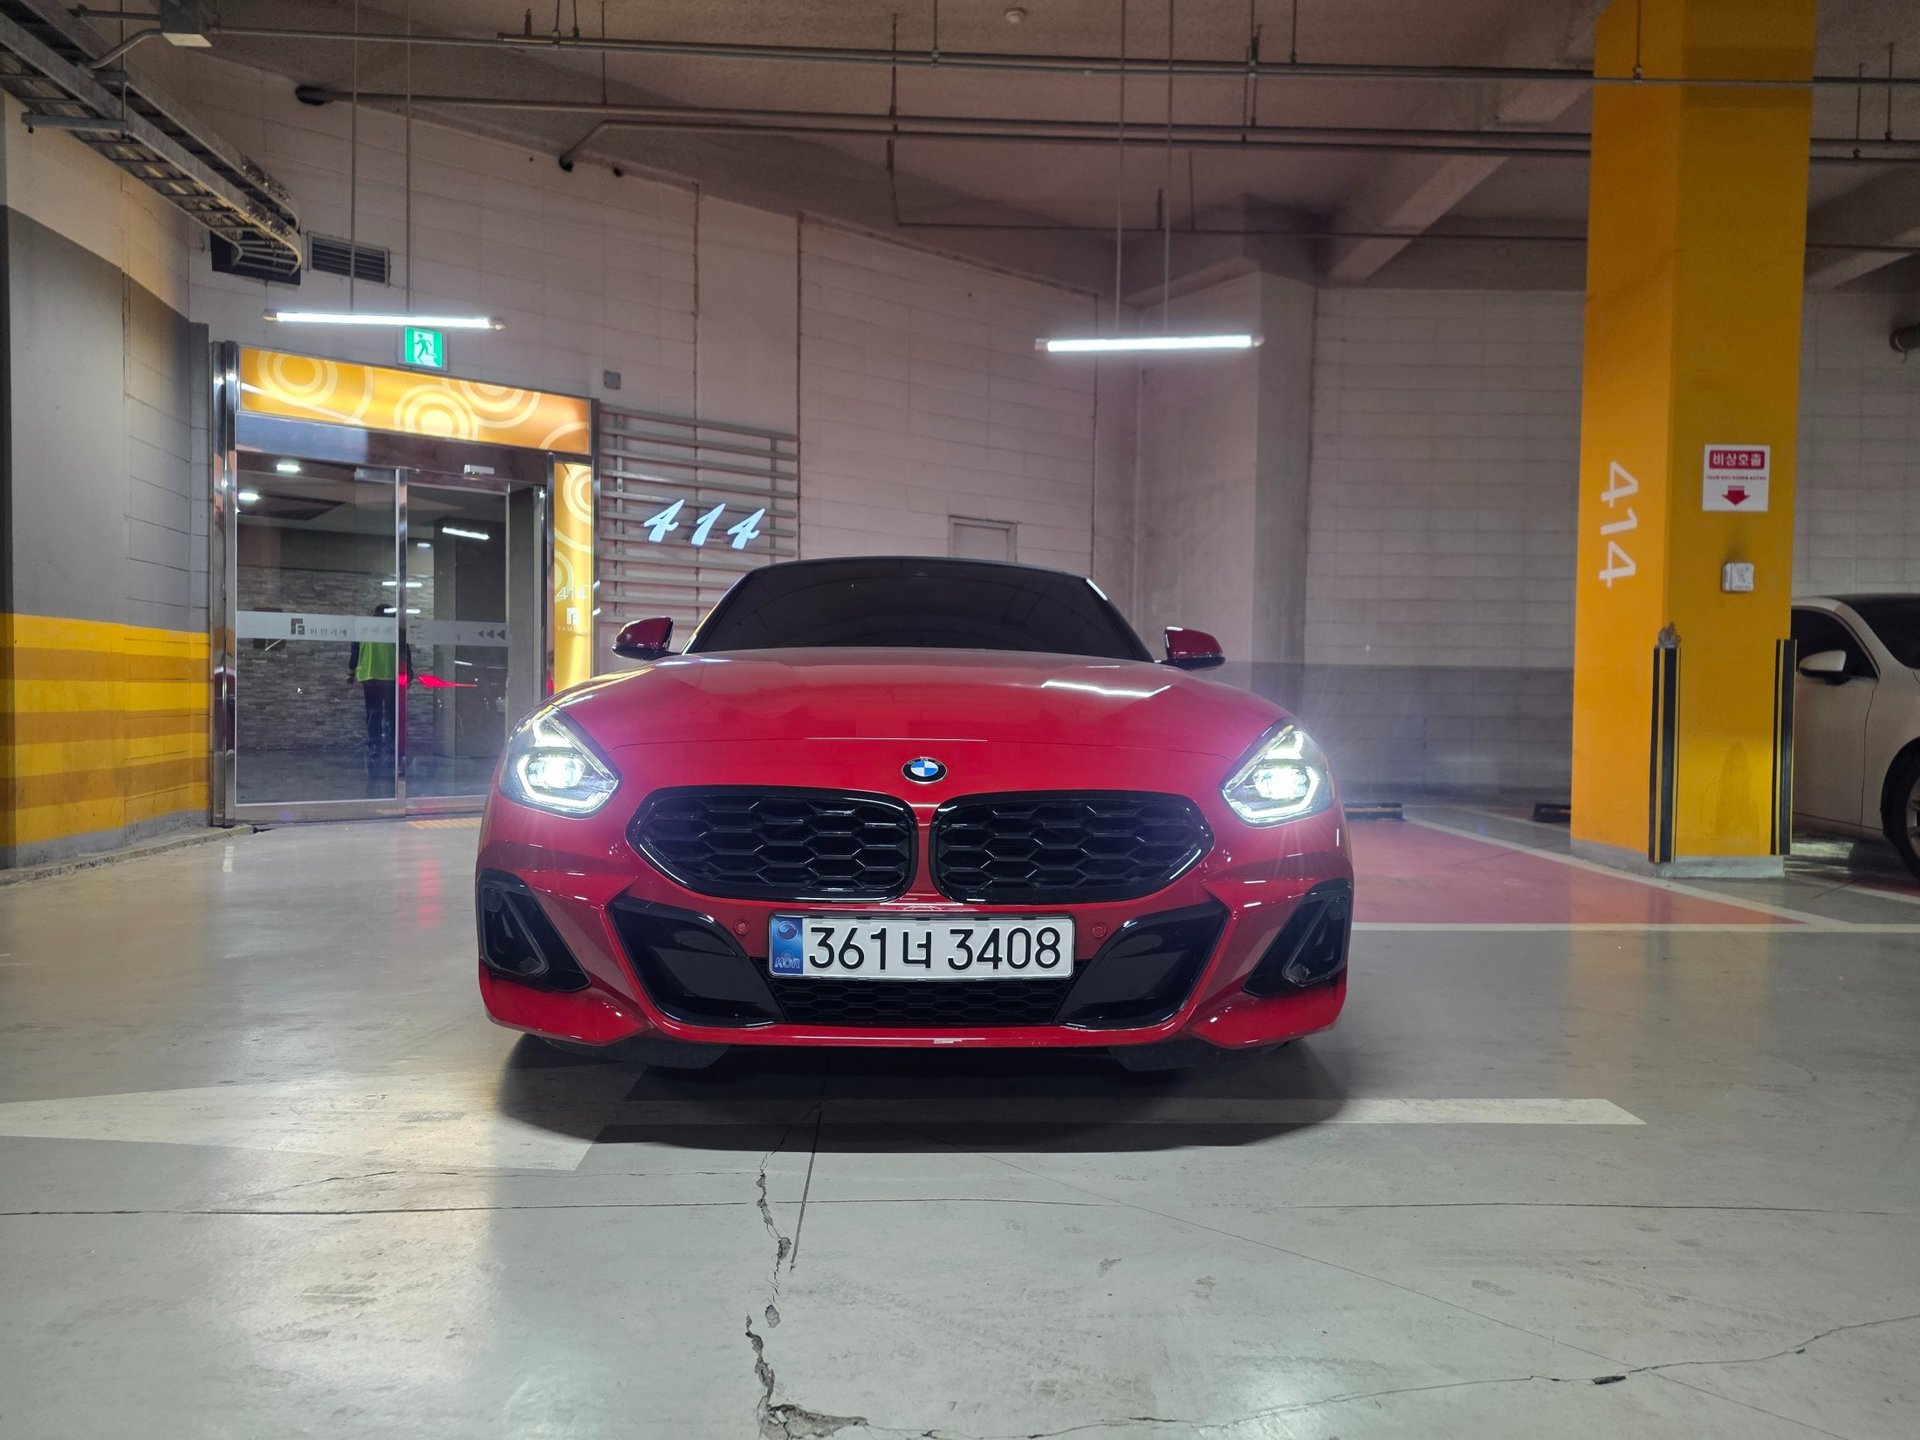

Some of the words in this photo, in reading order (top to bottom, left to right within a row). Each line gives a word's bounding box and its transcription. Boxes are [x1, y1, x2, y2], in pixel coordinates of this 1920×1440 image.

[1712, 452, 1762, 467] 비상호출
[643, 498, 766, 550] 414
[1598, 461, 1639, 588] 414
[556, 586, 587, 600] 414
[774, 957, 801, 969] KOR
[809, 927, 932, 970] 361너
[947, 927, 1061, 970] 3408
